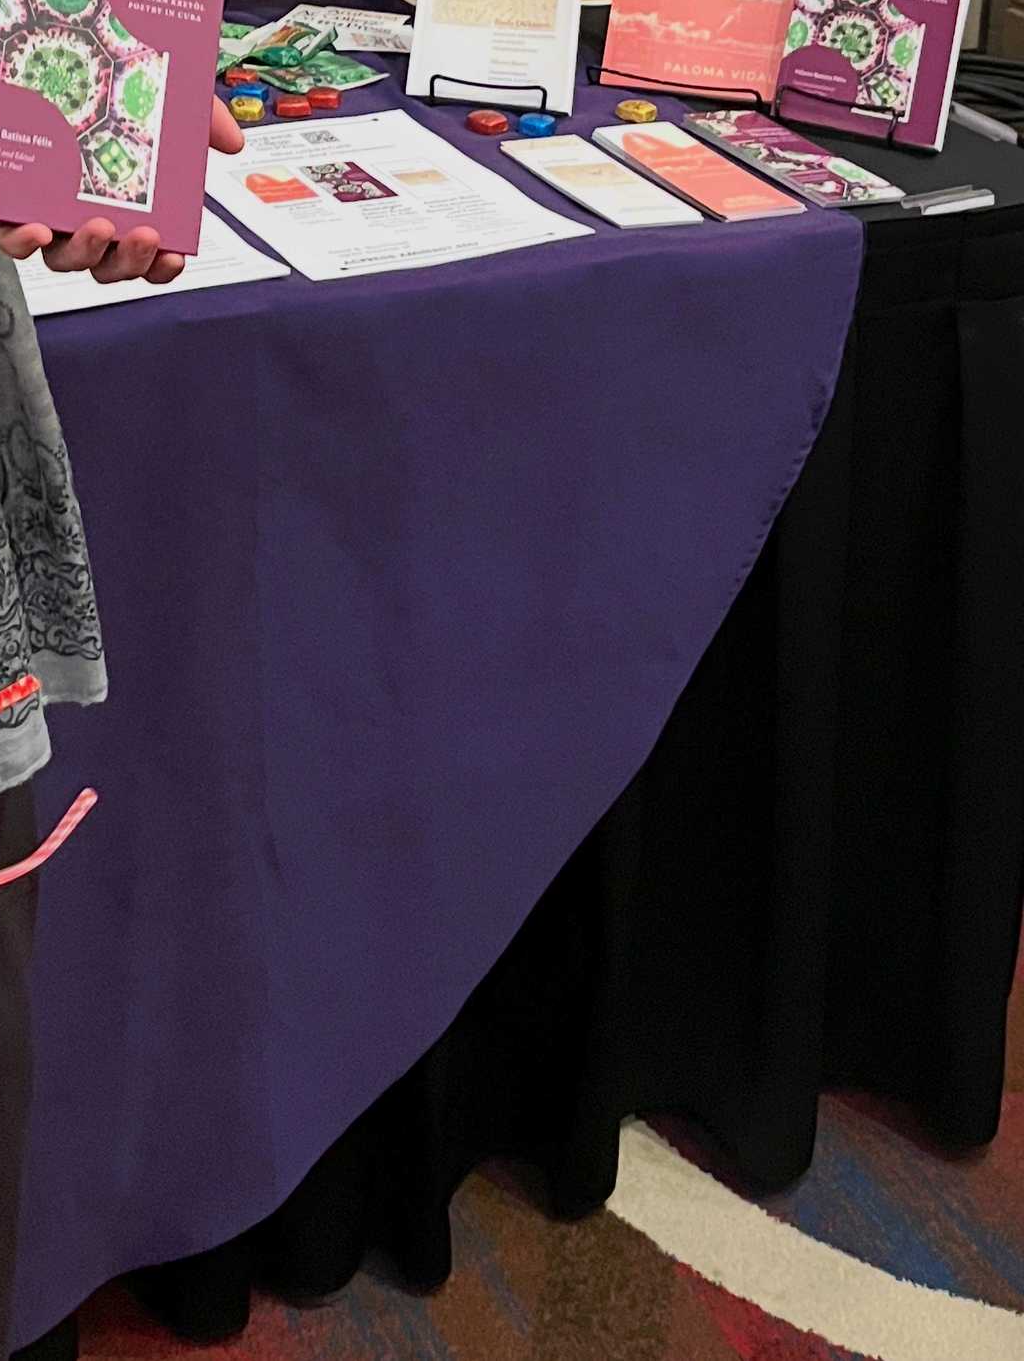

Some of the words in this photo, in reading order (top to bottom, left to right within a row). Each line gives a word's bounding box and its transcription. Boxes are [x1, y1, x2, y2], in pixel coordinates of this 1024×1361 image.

[128, 1, 162, 15] POETRY
[165, 7, 175, 17] IN
[178, 11, 201, 22] CUBA
[663, 61, 724, 79] PALOMA
[1, 128, 31, 145] Batista
